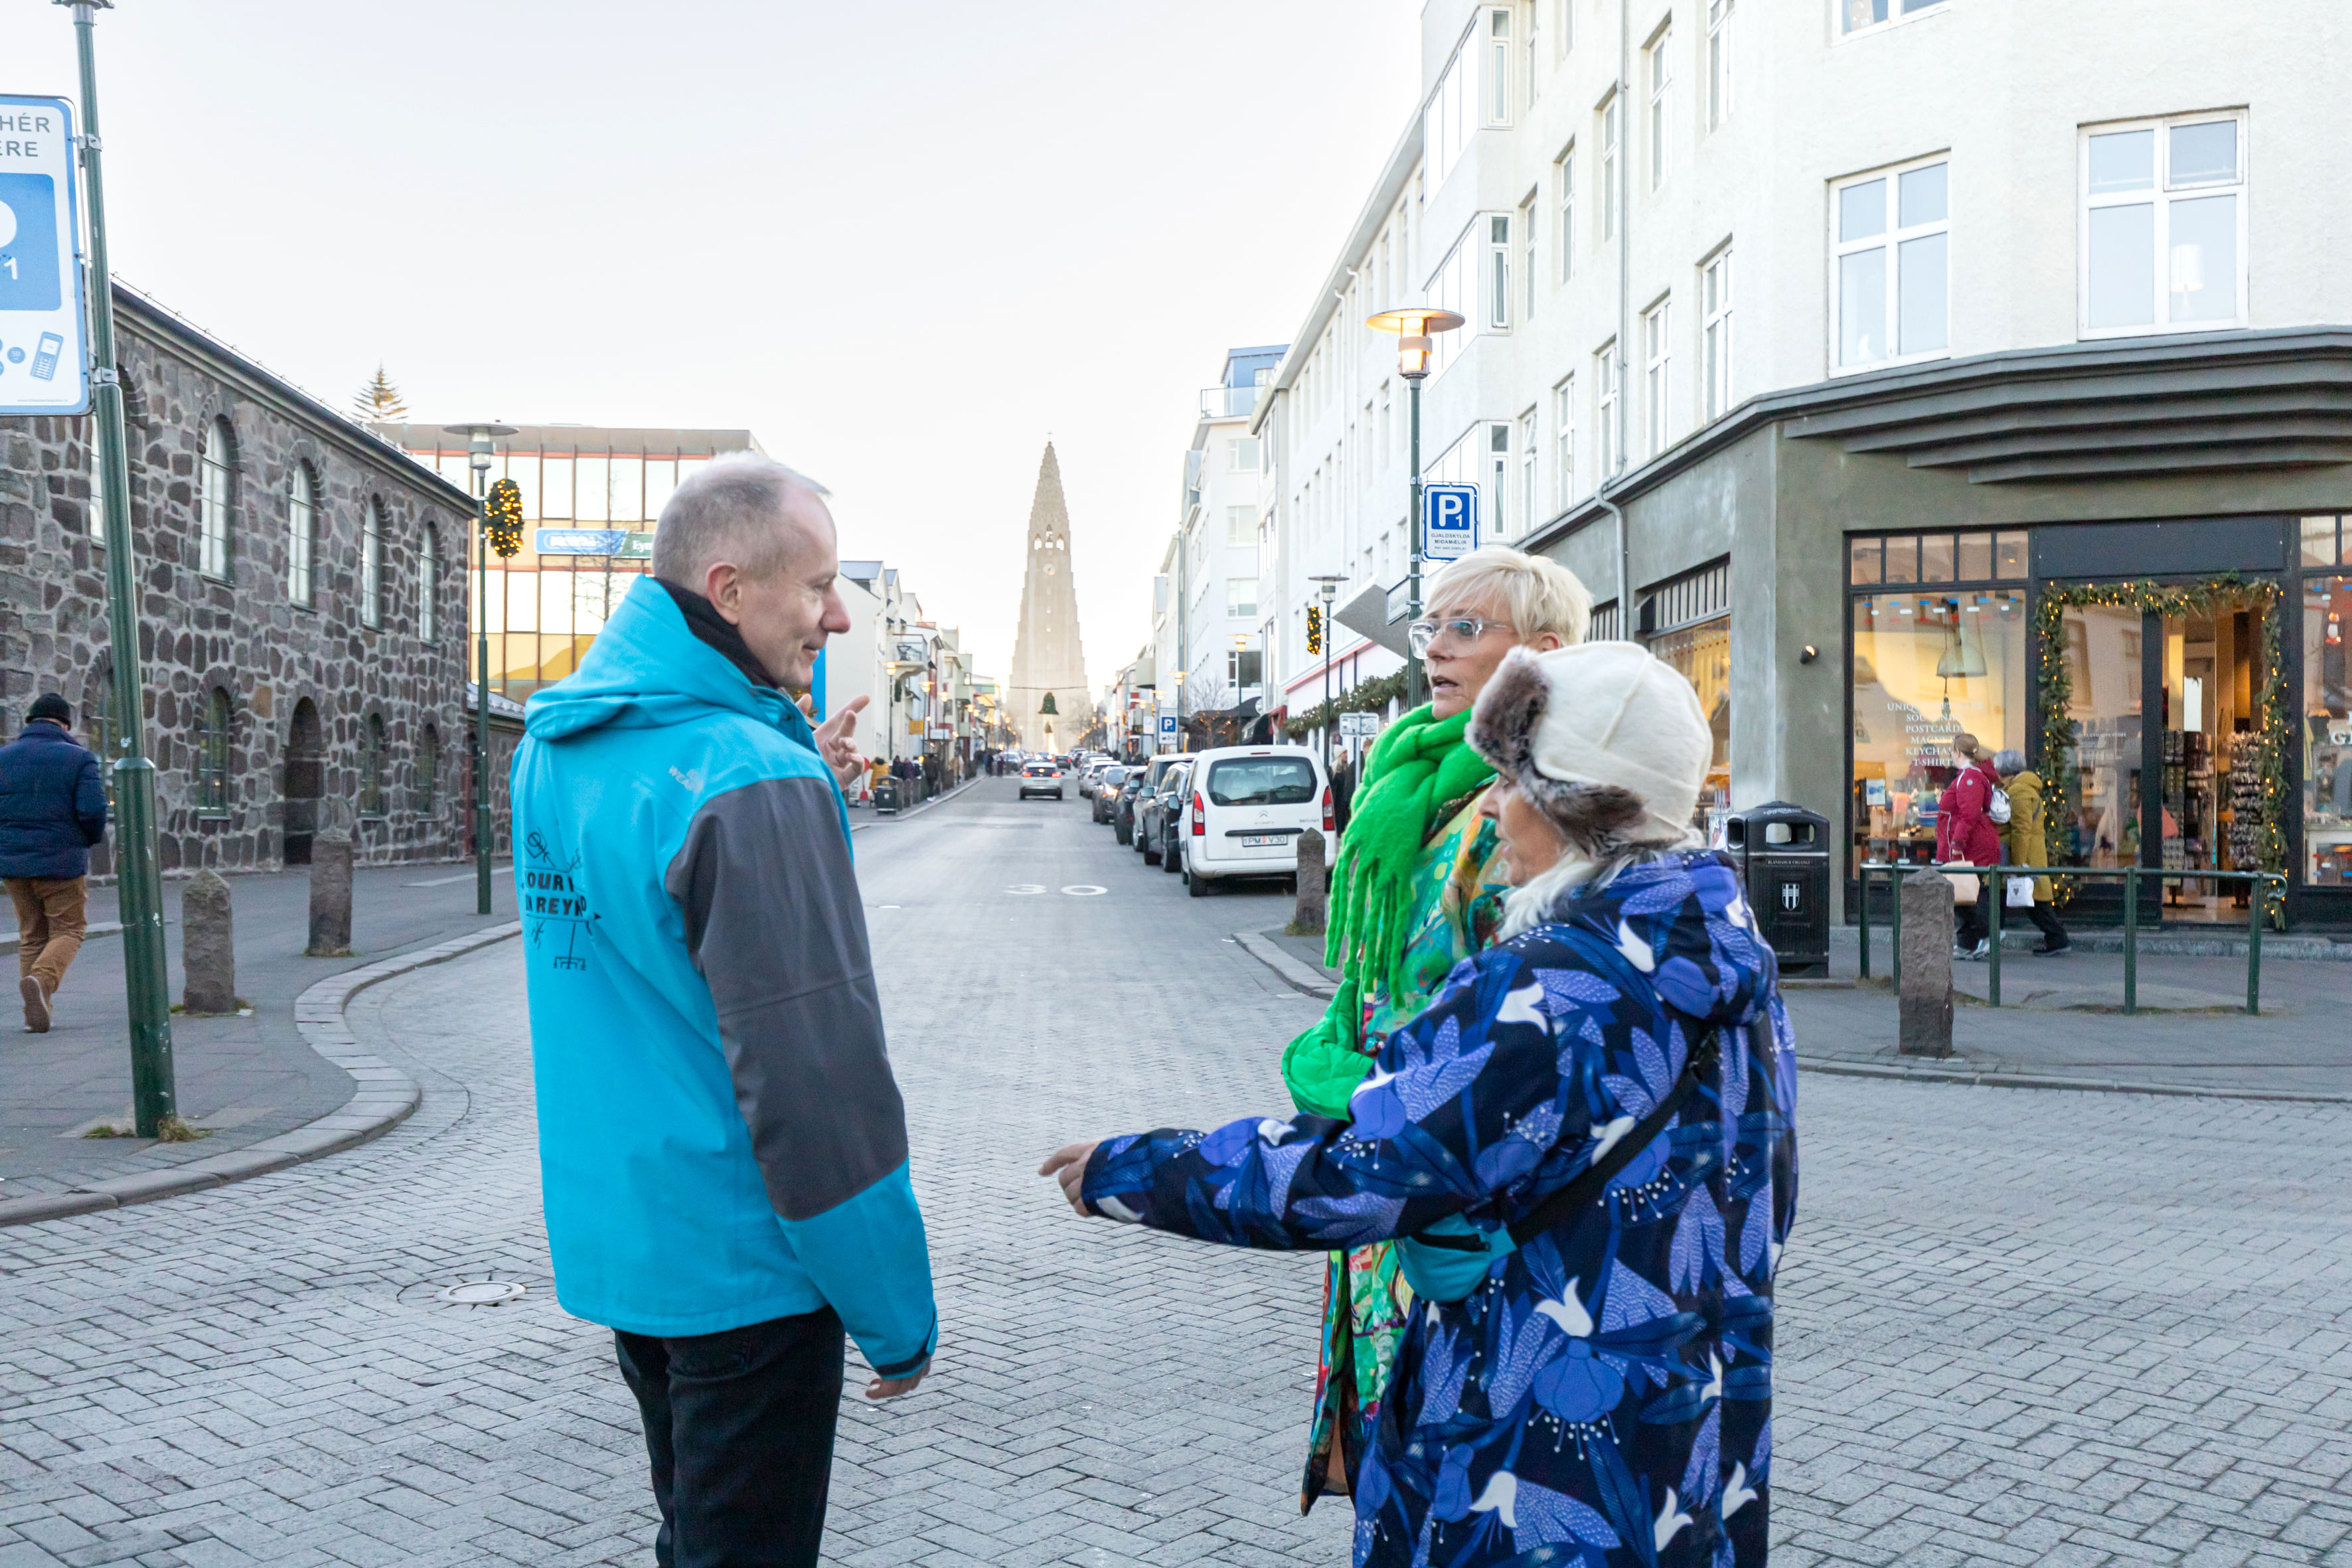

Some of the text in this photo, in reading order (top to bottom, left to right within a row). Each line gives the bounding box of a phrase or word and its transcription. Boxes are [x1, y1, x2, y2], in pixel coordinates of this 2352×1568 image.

[0, 141, 38, 157] RE
[1907, 713, 1962, 722] SOUNI
[521, 872, 564, 892] OUR
